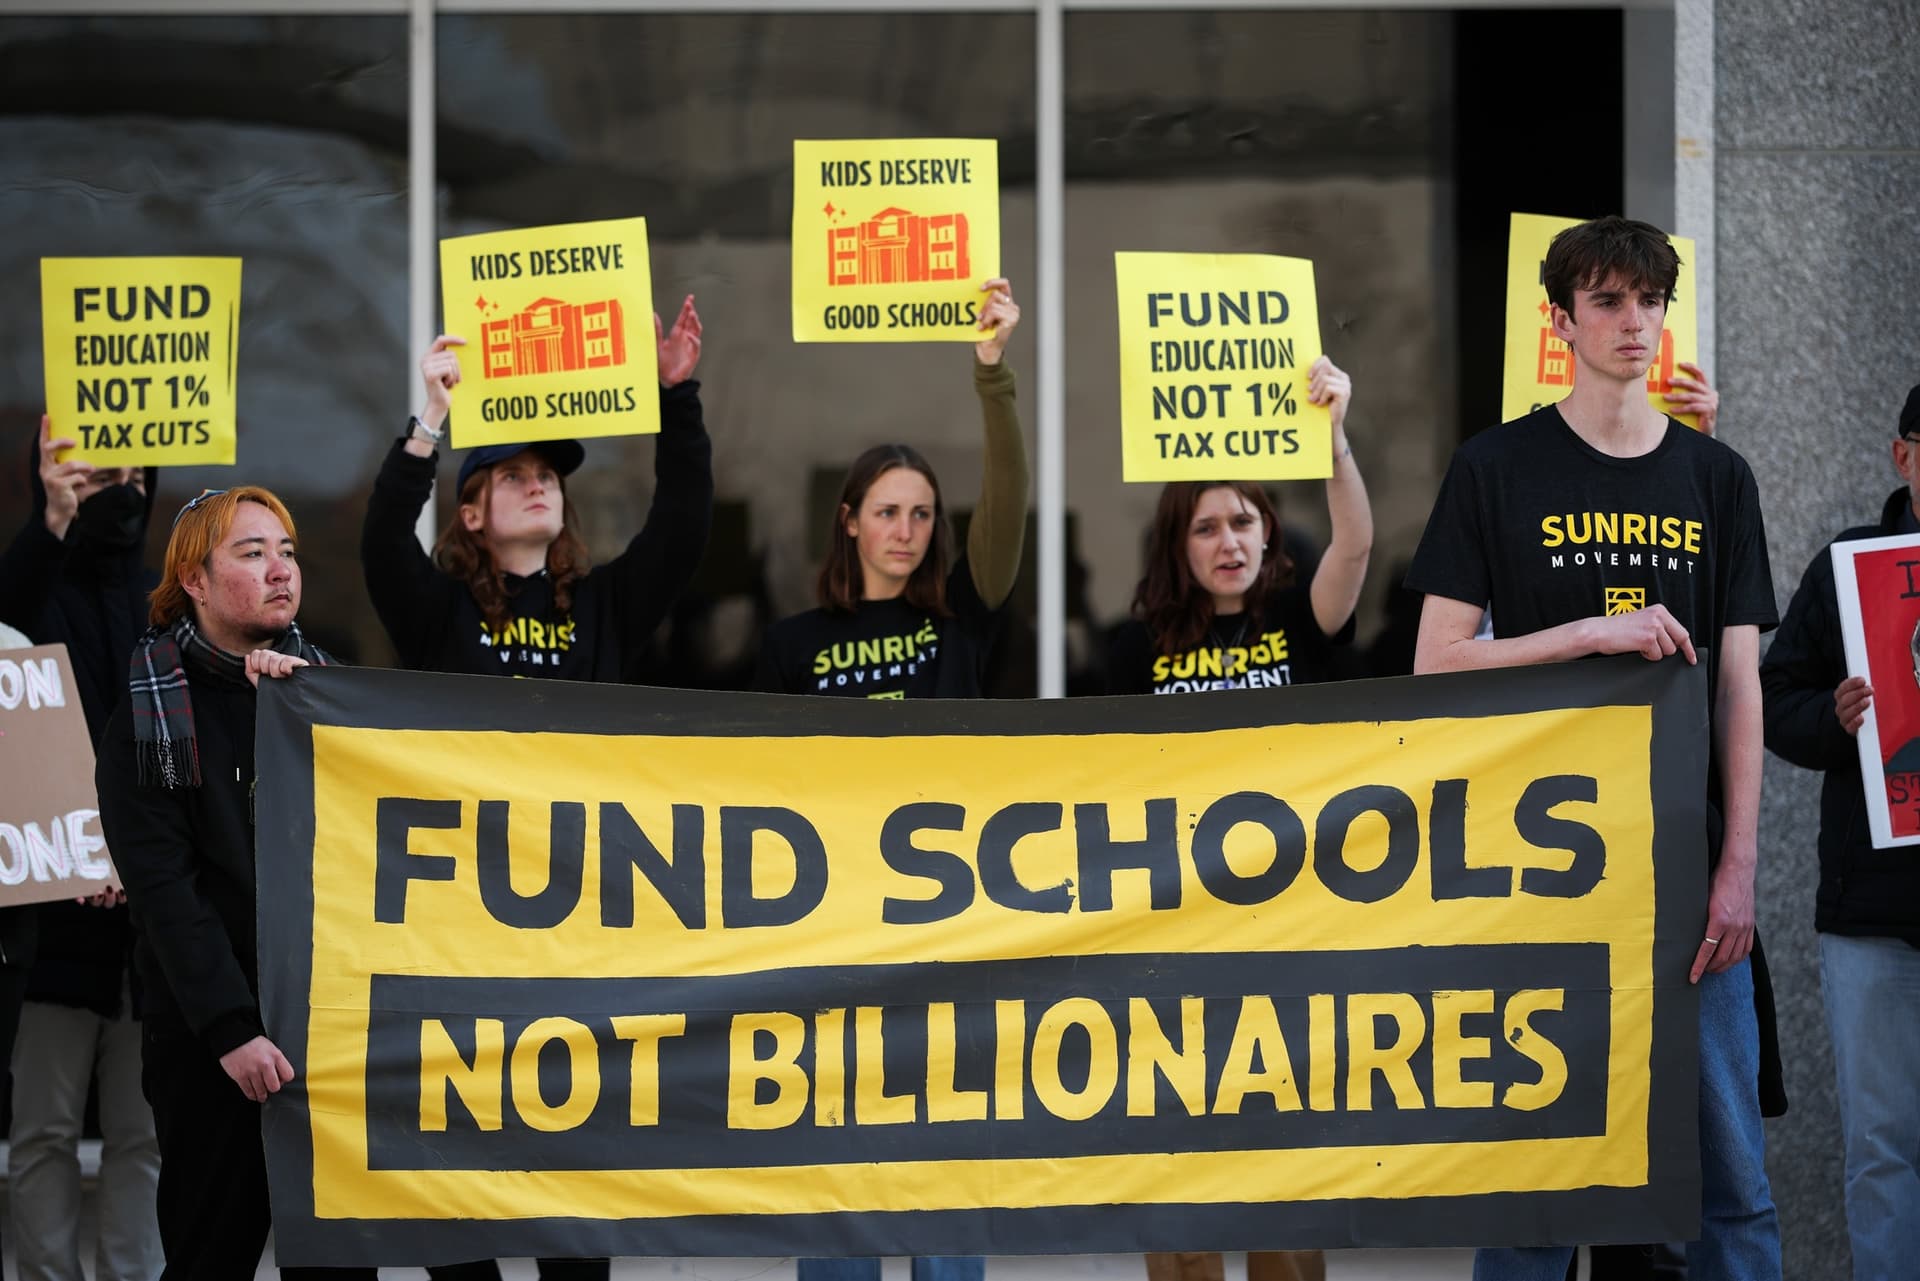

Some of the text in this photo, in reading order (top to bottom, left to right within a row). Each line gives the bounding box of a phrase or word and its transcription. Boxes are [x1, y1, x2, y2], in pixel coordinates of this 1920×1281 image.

[821, 159, 972, 187] KIDS DESERVE
[471, 244, 624, 281] KIDS DESERVE
[74, 285, 211, 322] FUND
[824, 302, 977, 329] GOOD SCHOOLS
[1147, 291, 1289, 328] FUND
[75, 331, 210, 366] EDUCATION
[1150, 338, 1295, 372] EDUCATION
[77, 375, 210, 413] NOT 1%
[481, 387, 636, 422] GOOD SCHOOLS
[1152, 382, 1297, 420] NOT 1%
[79, 420, 210, 450] TAX CUTS
[1154, 429, 1300, 459] TAX CUTS
[1541, 512, 1703, 554] SUNRISE
[1552, 551, 1694, 574] MOVEMENT
[480, 617, 576, 651] NRIS
[374, 774, 1607, 930] FUND SCHOOLS
[418, 988, 1567, 1132] NOT BILLIONAIRES
